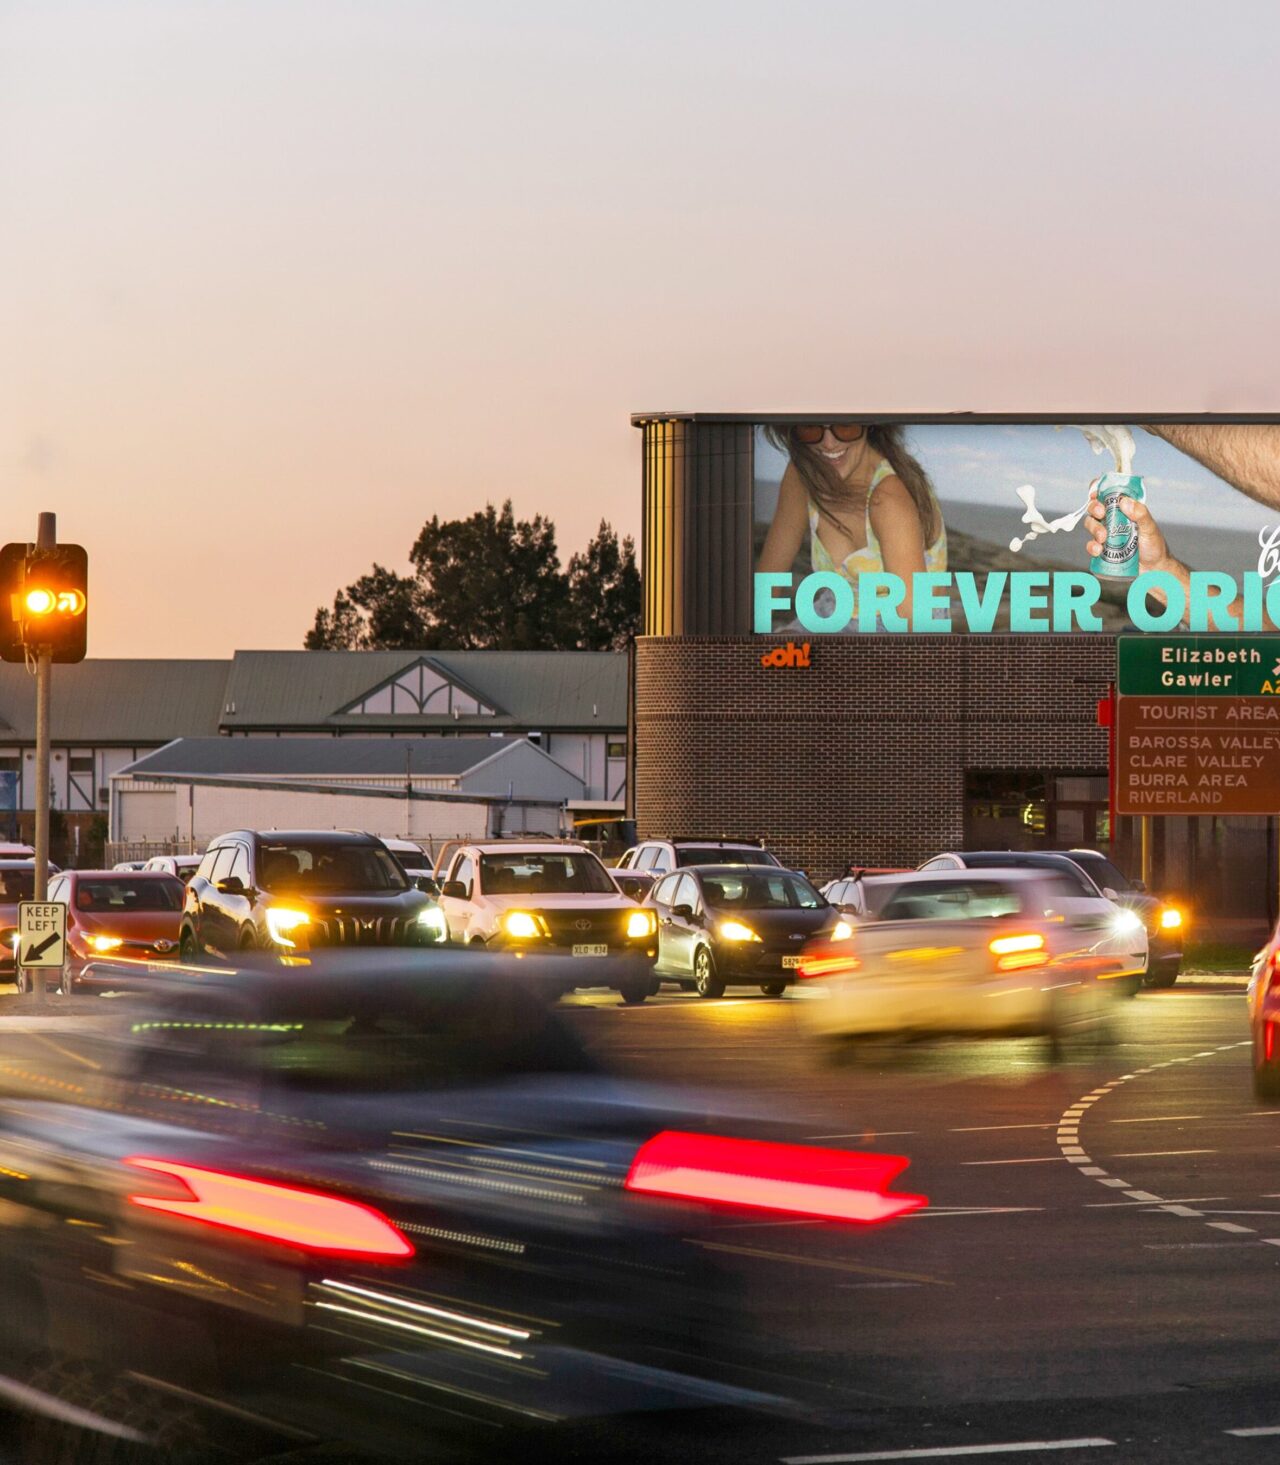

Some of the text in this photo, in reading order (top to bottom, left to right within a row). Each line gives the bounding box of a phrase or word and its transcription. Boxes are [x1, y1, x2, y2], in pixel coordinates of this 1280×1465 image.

[753, 570, 1104, 634] FOREVER
[1161, 647, 1261, 663] Elizabeth
[1161, 671, 1233, 687] Gawler
[1139, 706, 1219, 720] TOURIST
[1129, 736, 1213, 749] BAROSSA
[1129, 755, 1265, 768] CLARE VALLEY
[1129, 774, 1248, 787] BURRA AREA
[1129, 791, 1223, 804] RIVERLAND
[26, 906, 59, 917] KEEP
[27, 921, 57, 931] LEFT
